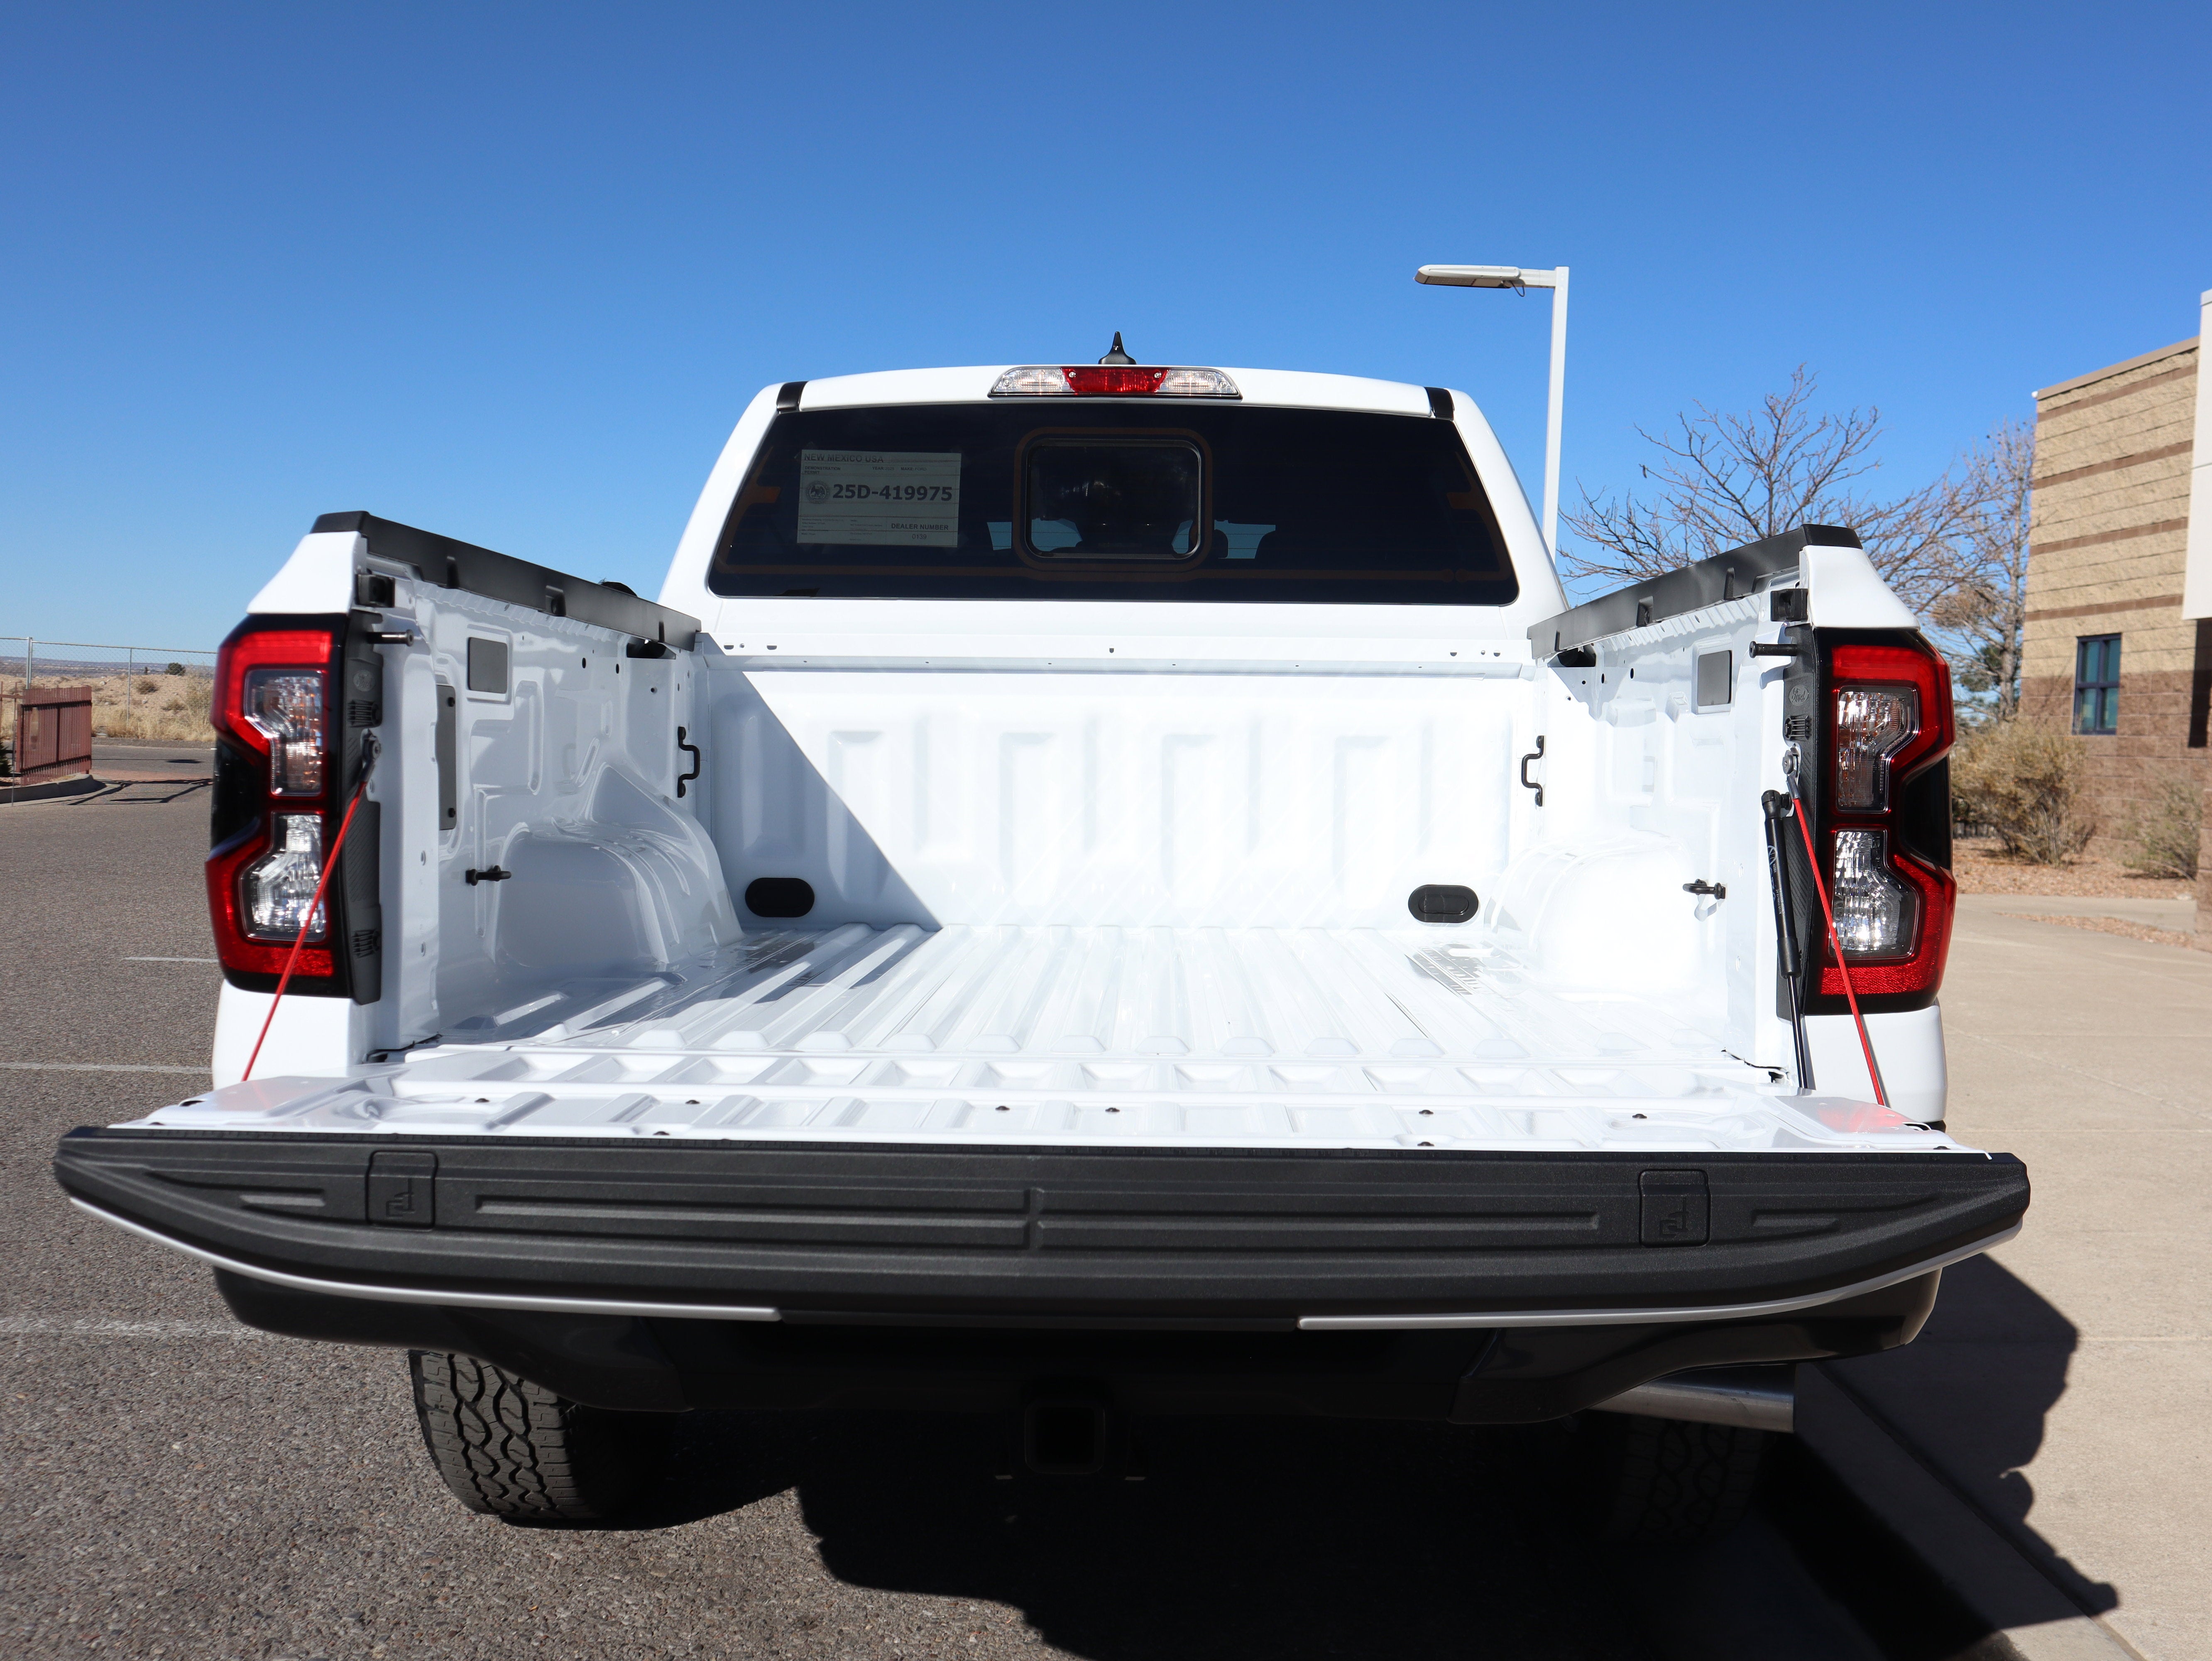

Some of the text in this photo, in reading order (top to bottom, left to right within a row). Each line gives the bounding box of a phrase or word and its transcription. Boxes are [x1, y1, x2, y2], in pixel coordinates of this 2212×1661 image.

[827, 454, 862, 462] MEXICO
[832, 484, 952, 501] 25D-419975
[1791, 687, 1806, 703] Ford
